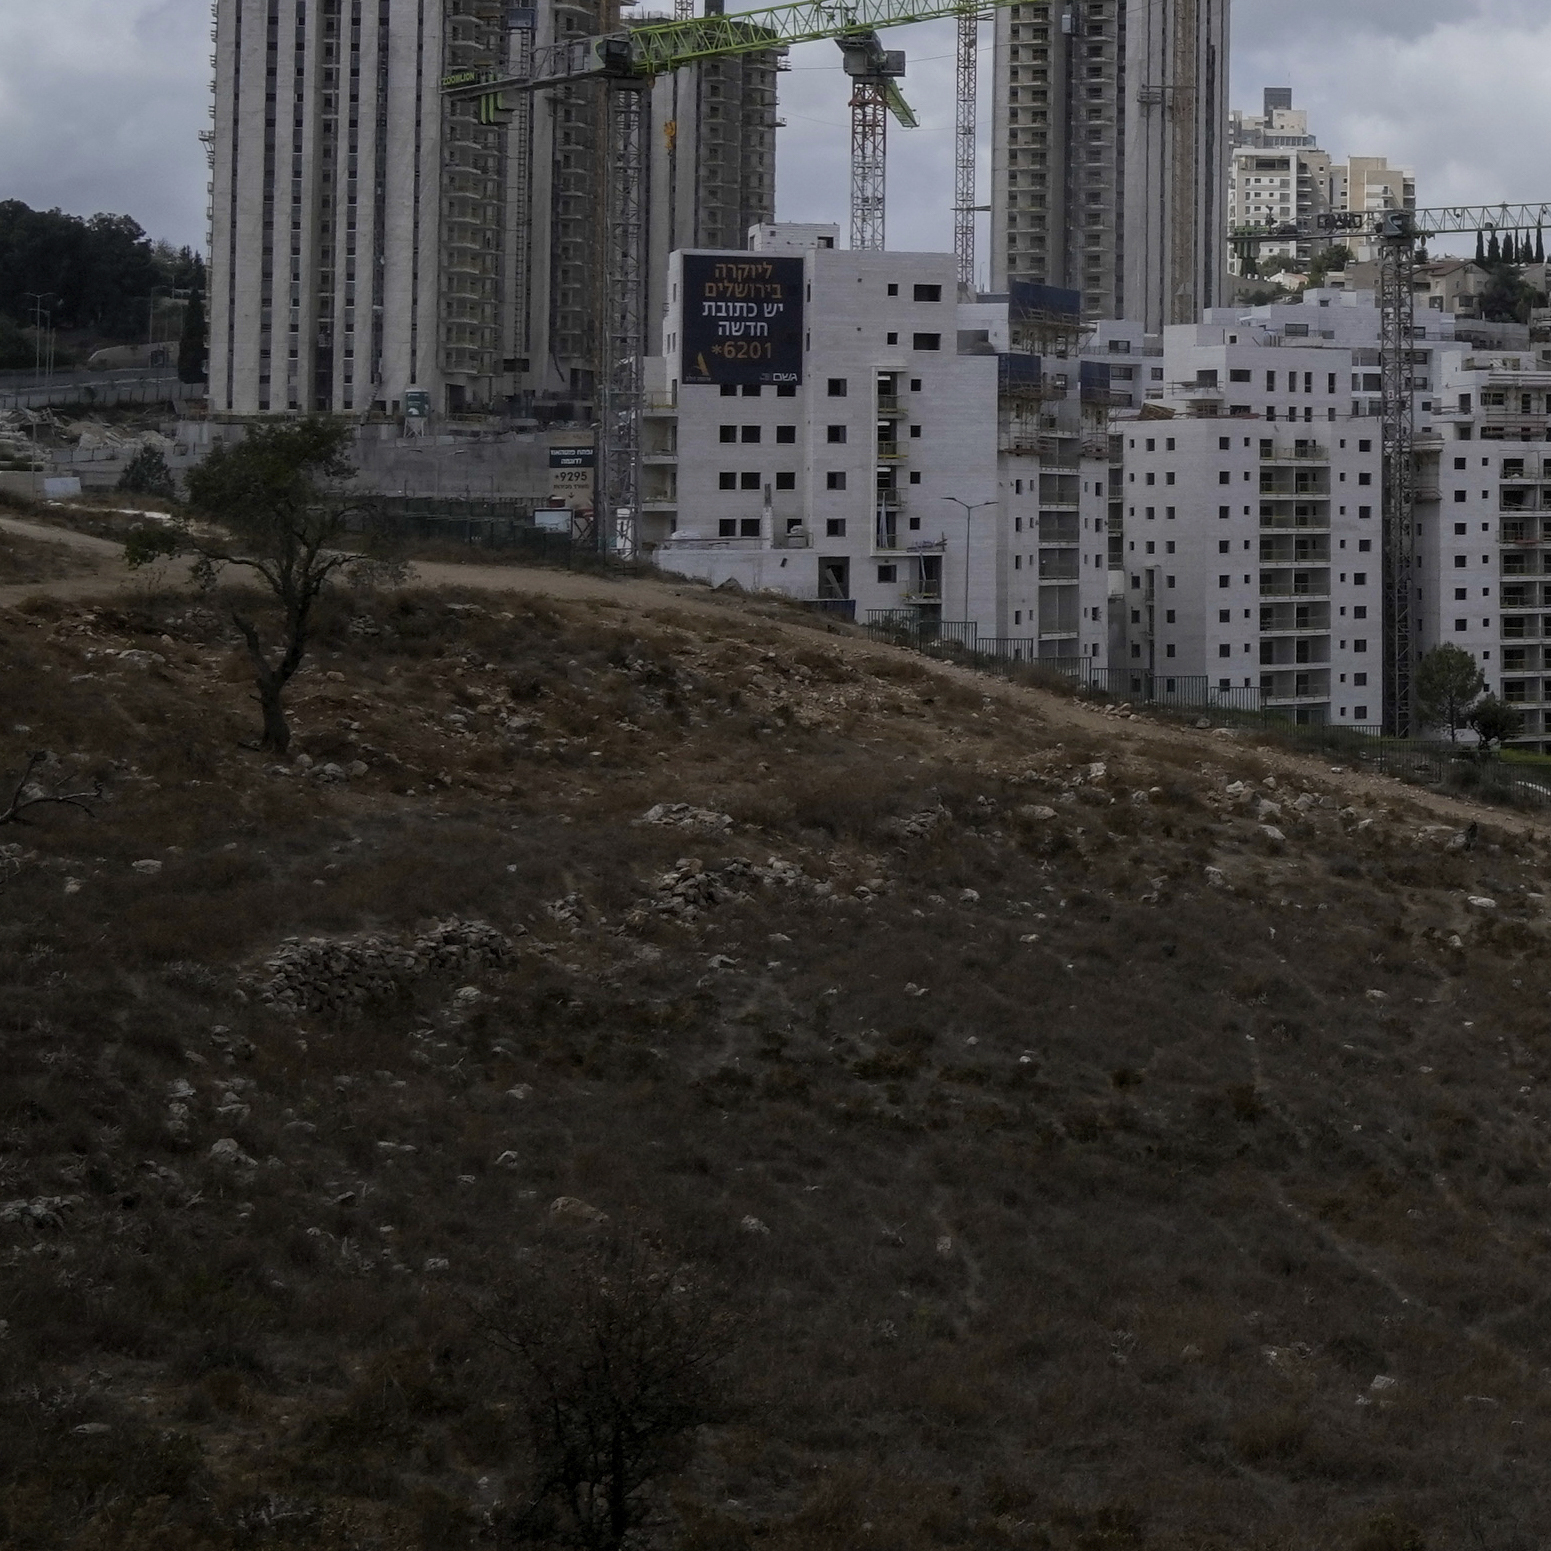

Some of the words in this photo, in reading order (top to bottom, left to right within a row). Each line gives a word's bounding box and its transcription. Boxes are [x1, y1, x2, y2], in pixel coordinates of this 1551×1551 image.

[441, 72, 475, 86] ZOOMLION
[714, 261, 773, 283] ליוקרה
[704, 280, 782, 298] בירושלים
[702, 302, 758, 317] כתובת
[763, 303, 784, 317] יש
[718, 321, 769, 336] חדשה
